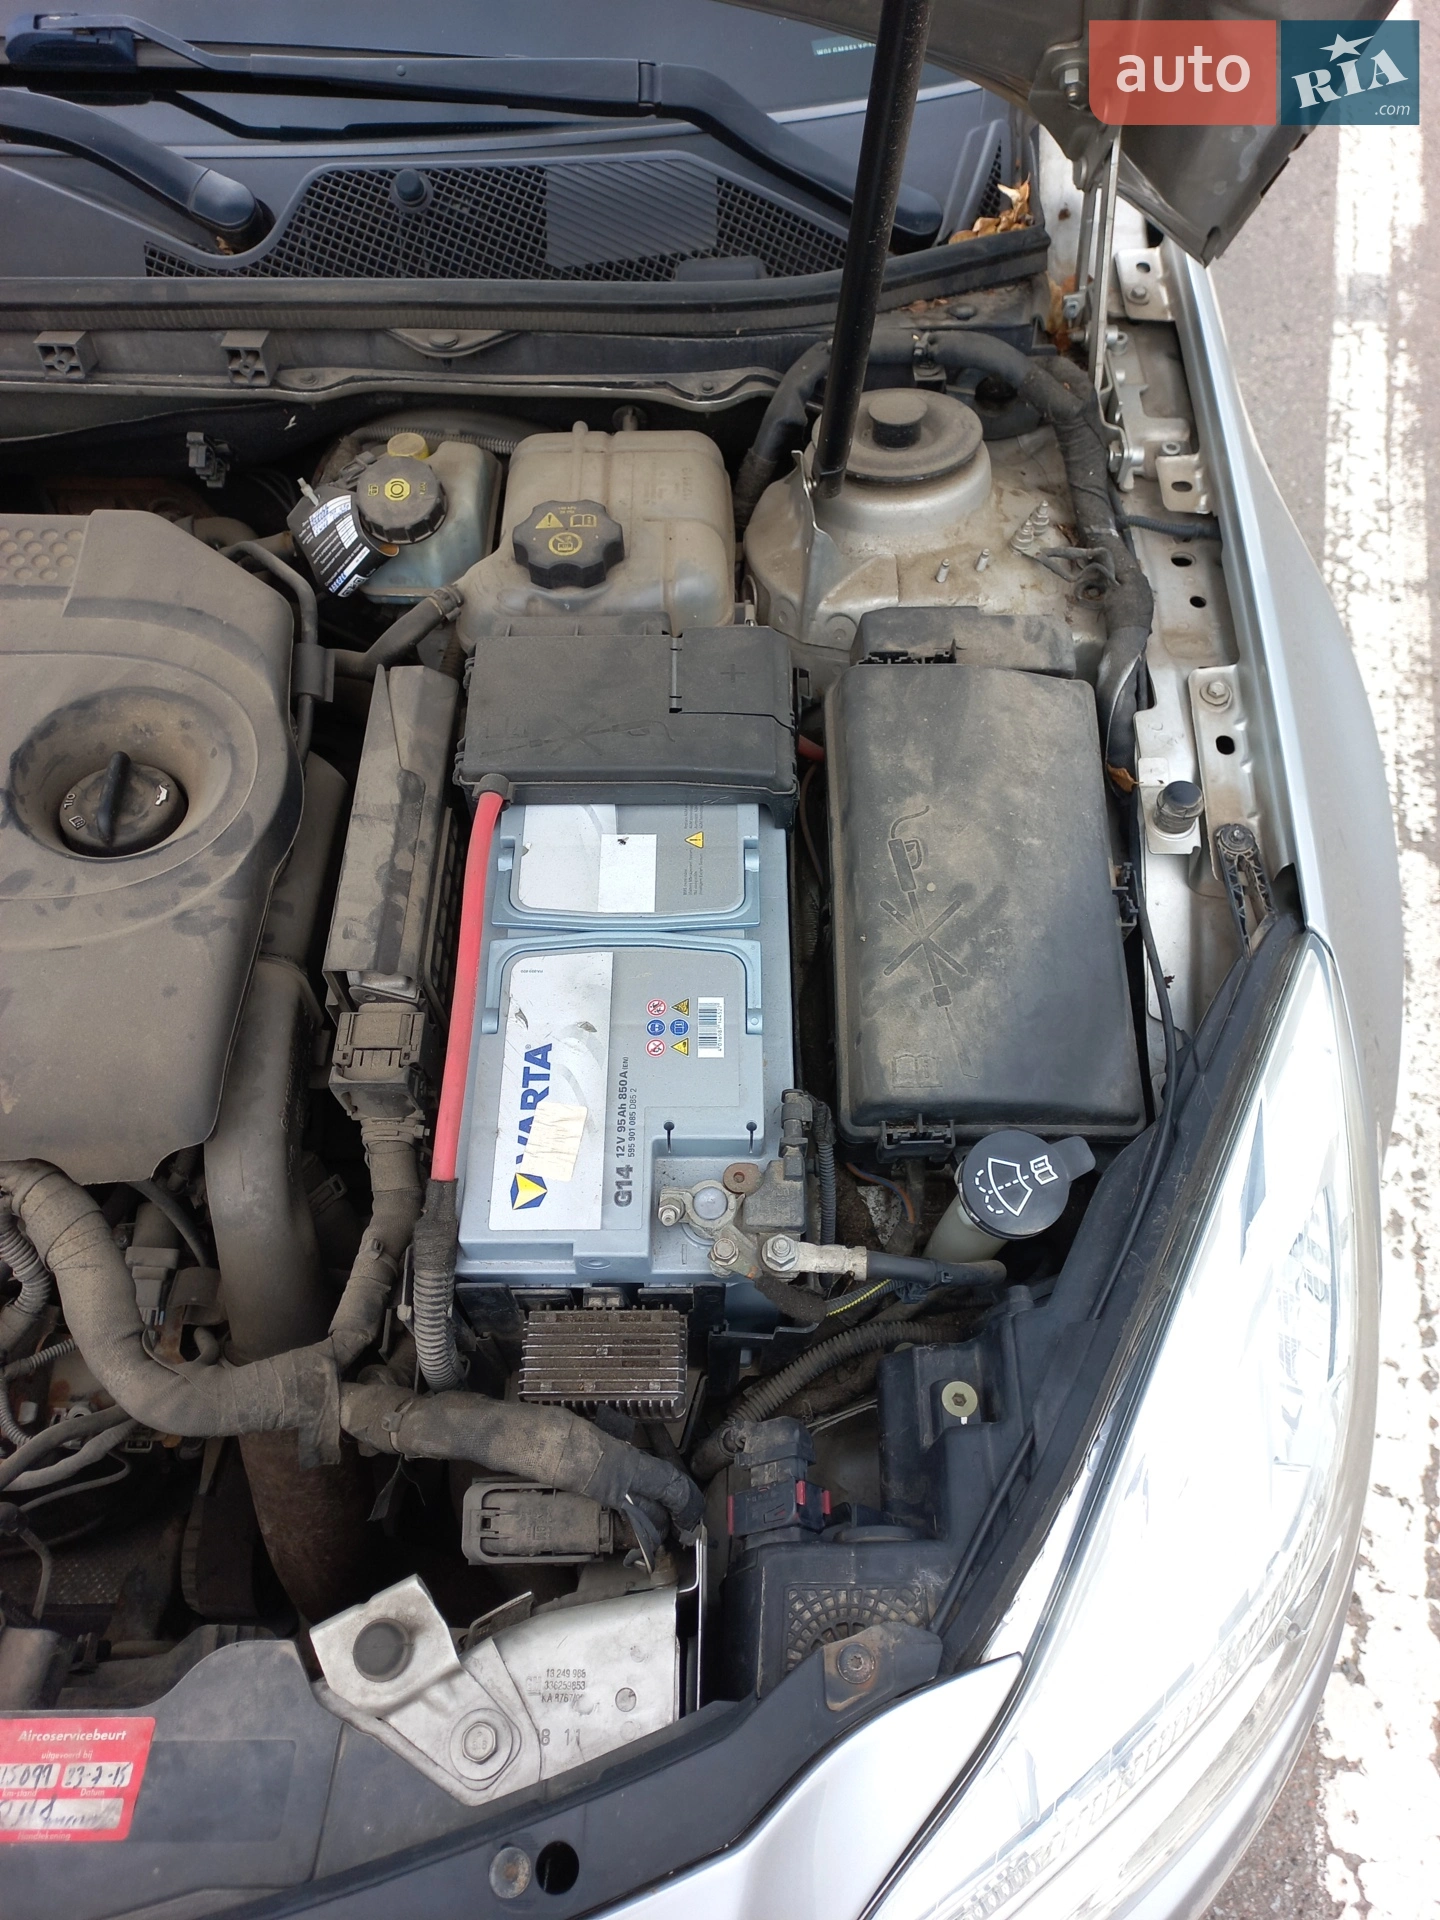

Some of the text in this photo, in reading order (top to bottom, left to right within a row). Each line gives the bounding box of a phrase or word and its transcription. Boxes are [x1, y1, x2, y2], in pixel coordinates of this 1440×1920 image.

[63, 793, 77, 810] OIL
[629, 1093, 637, 1110] D85
[628, 1127, 636, 1142] 901
[616, 1137, 626, 1158] 12V
[613, 1164, 633, 1207] G14
[546, 1668, 555, 1678] 13
[557, 1668, 570, 1678] 249
[18, 1729, 127, 1742] Aircoservicebeurt
[41, 1750, 94, 1760] uitgevoerd bij
[80, 1789, 105, 1797] Datum
